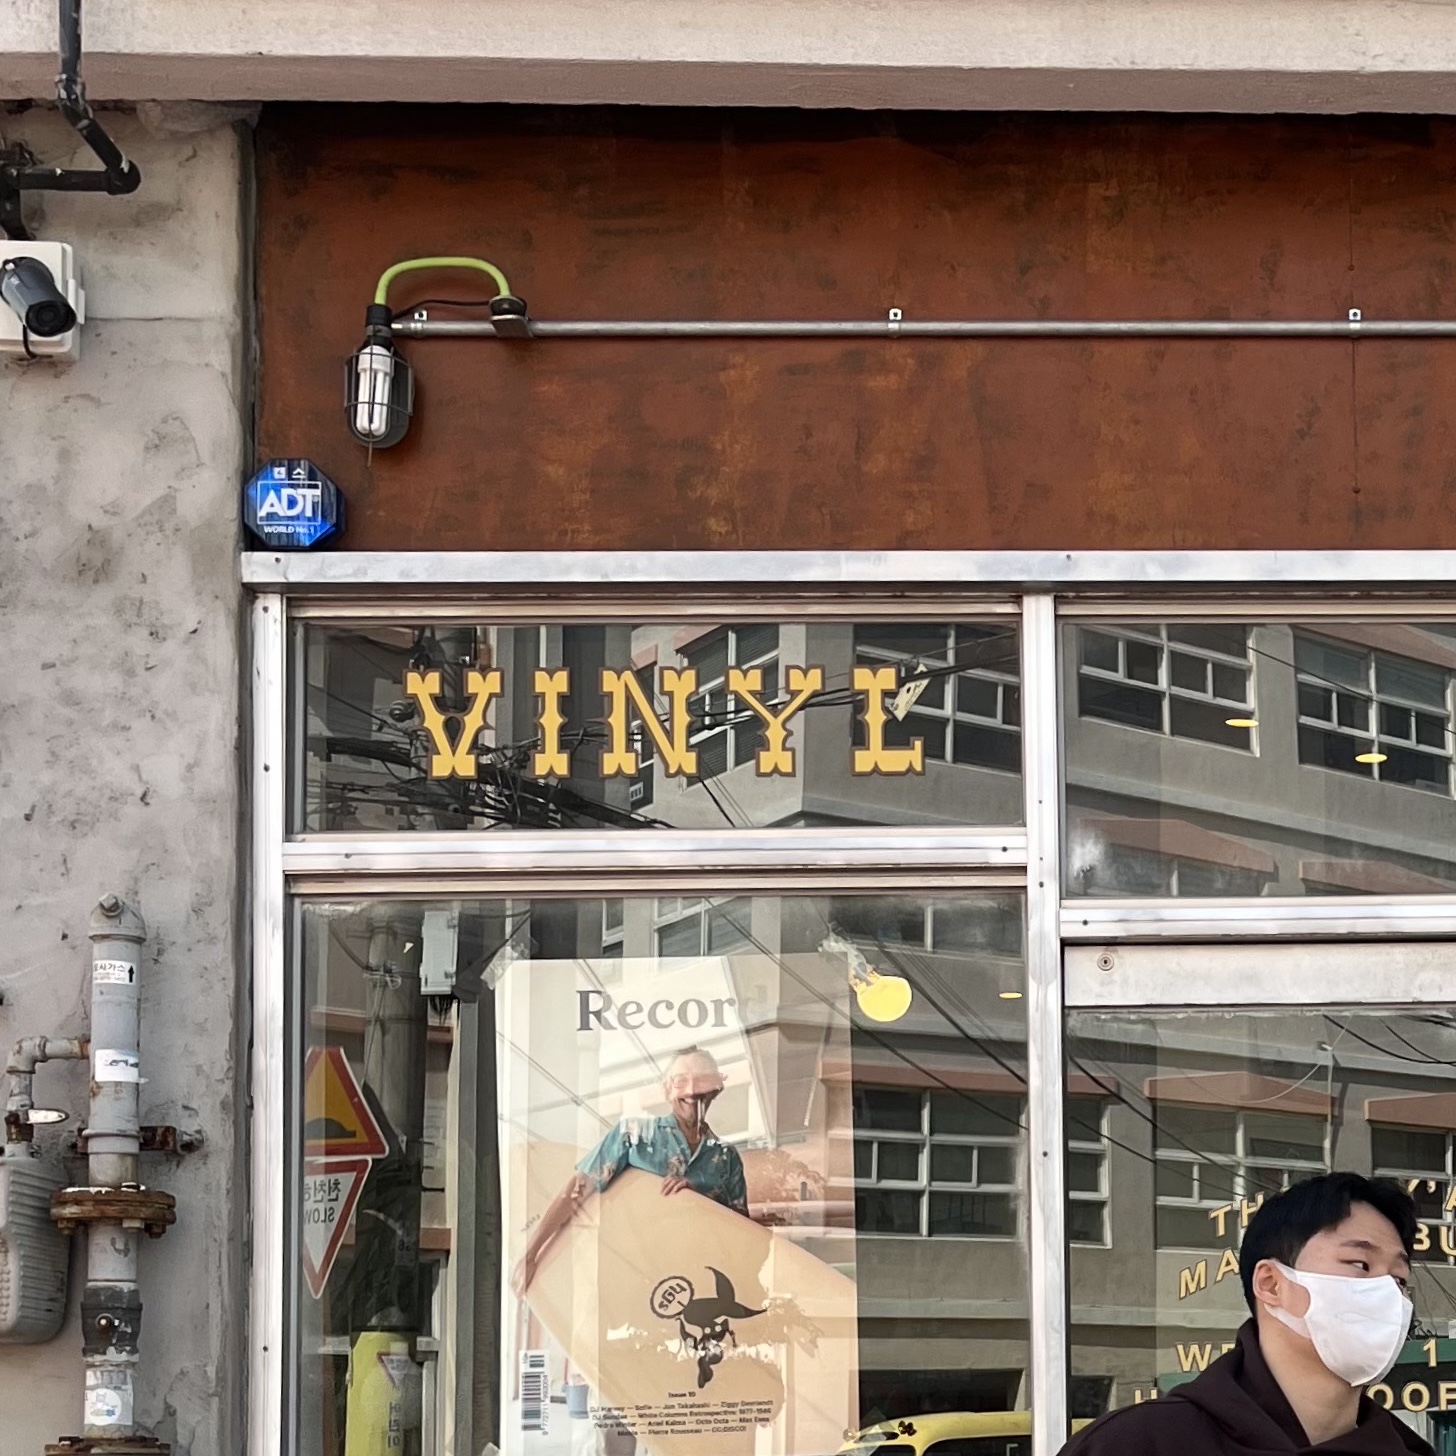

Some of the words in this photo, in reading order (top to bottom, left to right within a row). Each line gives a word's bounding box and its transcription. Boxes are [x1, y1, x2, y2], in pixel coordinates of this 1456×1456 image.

[259, 488, 320, 517] ADT
[264, 525, 295, 533] WORLD
[403, 667, 925, 777] VINYL
[576, 989, 737, 1032] Recor
[1422, 1337, 1438, 1368] 1
